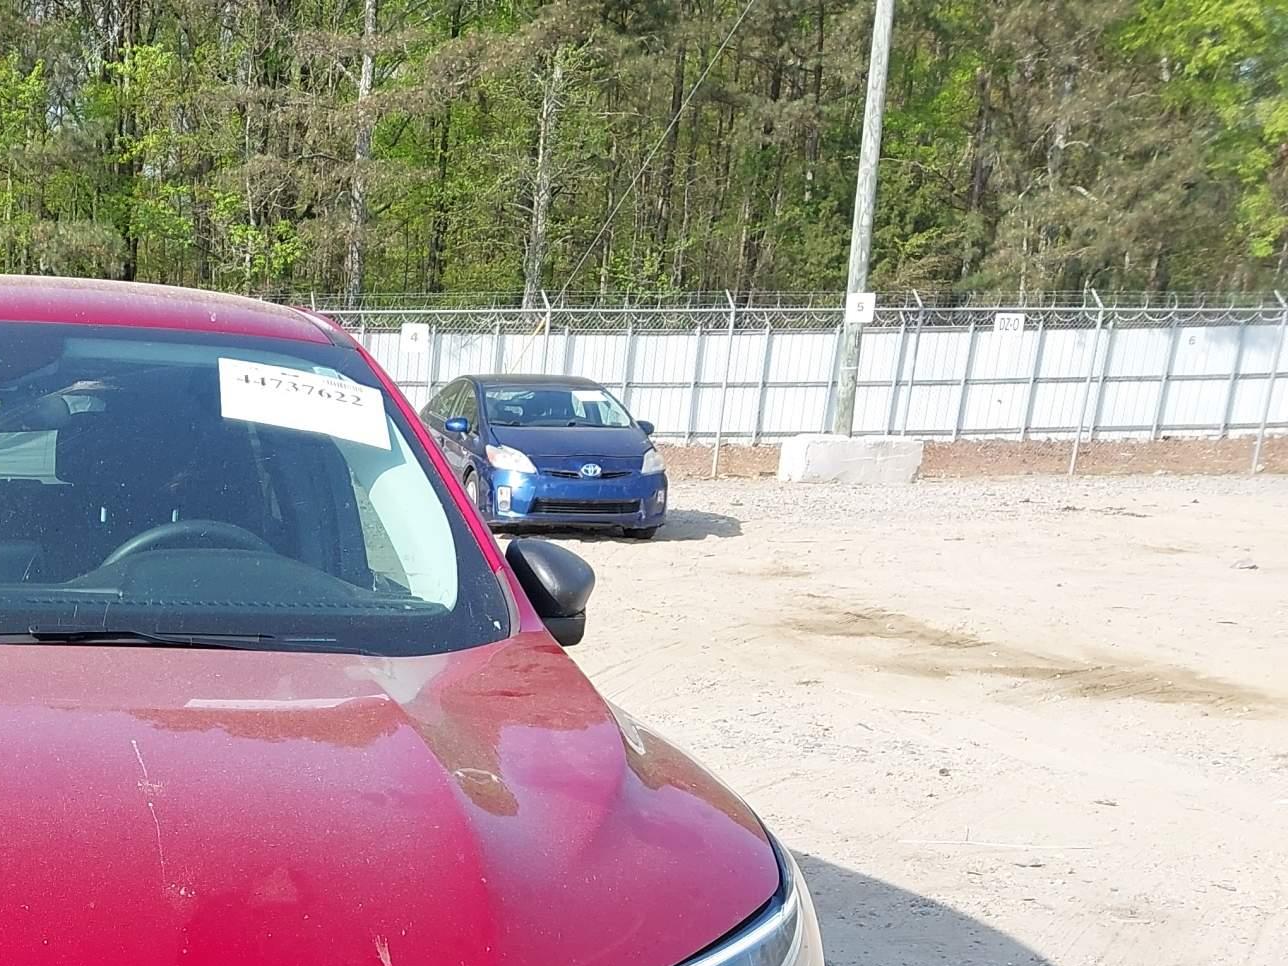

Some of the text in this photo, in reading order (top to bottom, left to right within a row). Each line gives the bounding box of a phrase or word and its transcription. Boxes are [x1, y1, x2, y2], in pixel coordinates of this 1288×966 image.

[857, 302, 864, 312] 5
[410, 332, 418, 342] 4
[1188, 335, 1196, 346] 6
[236, 374, 363, 406] 44737622
